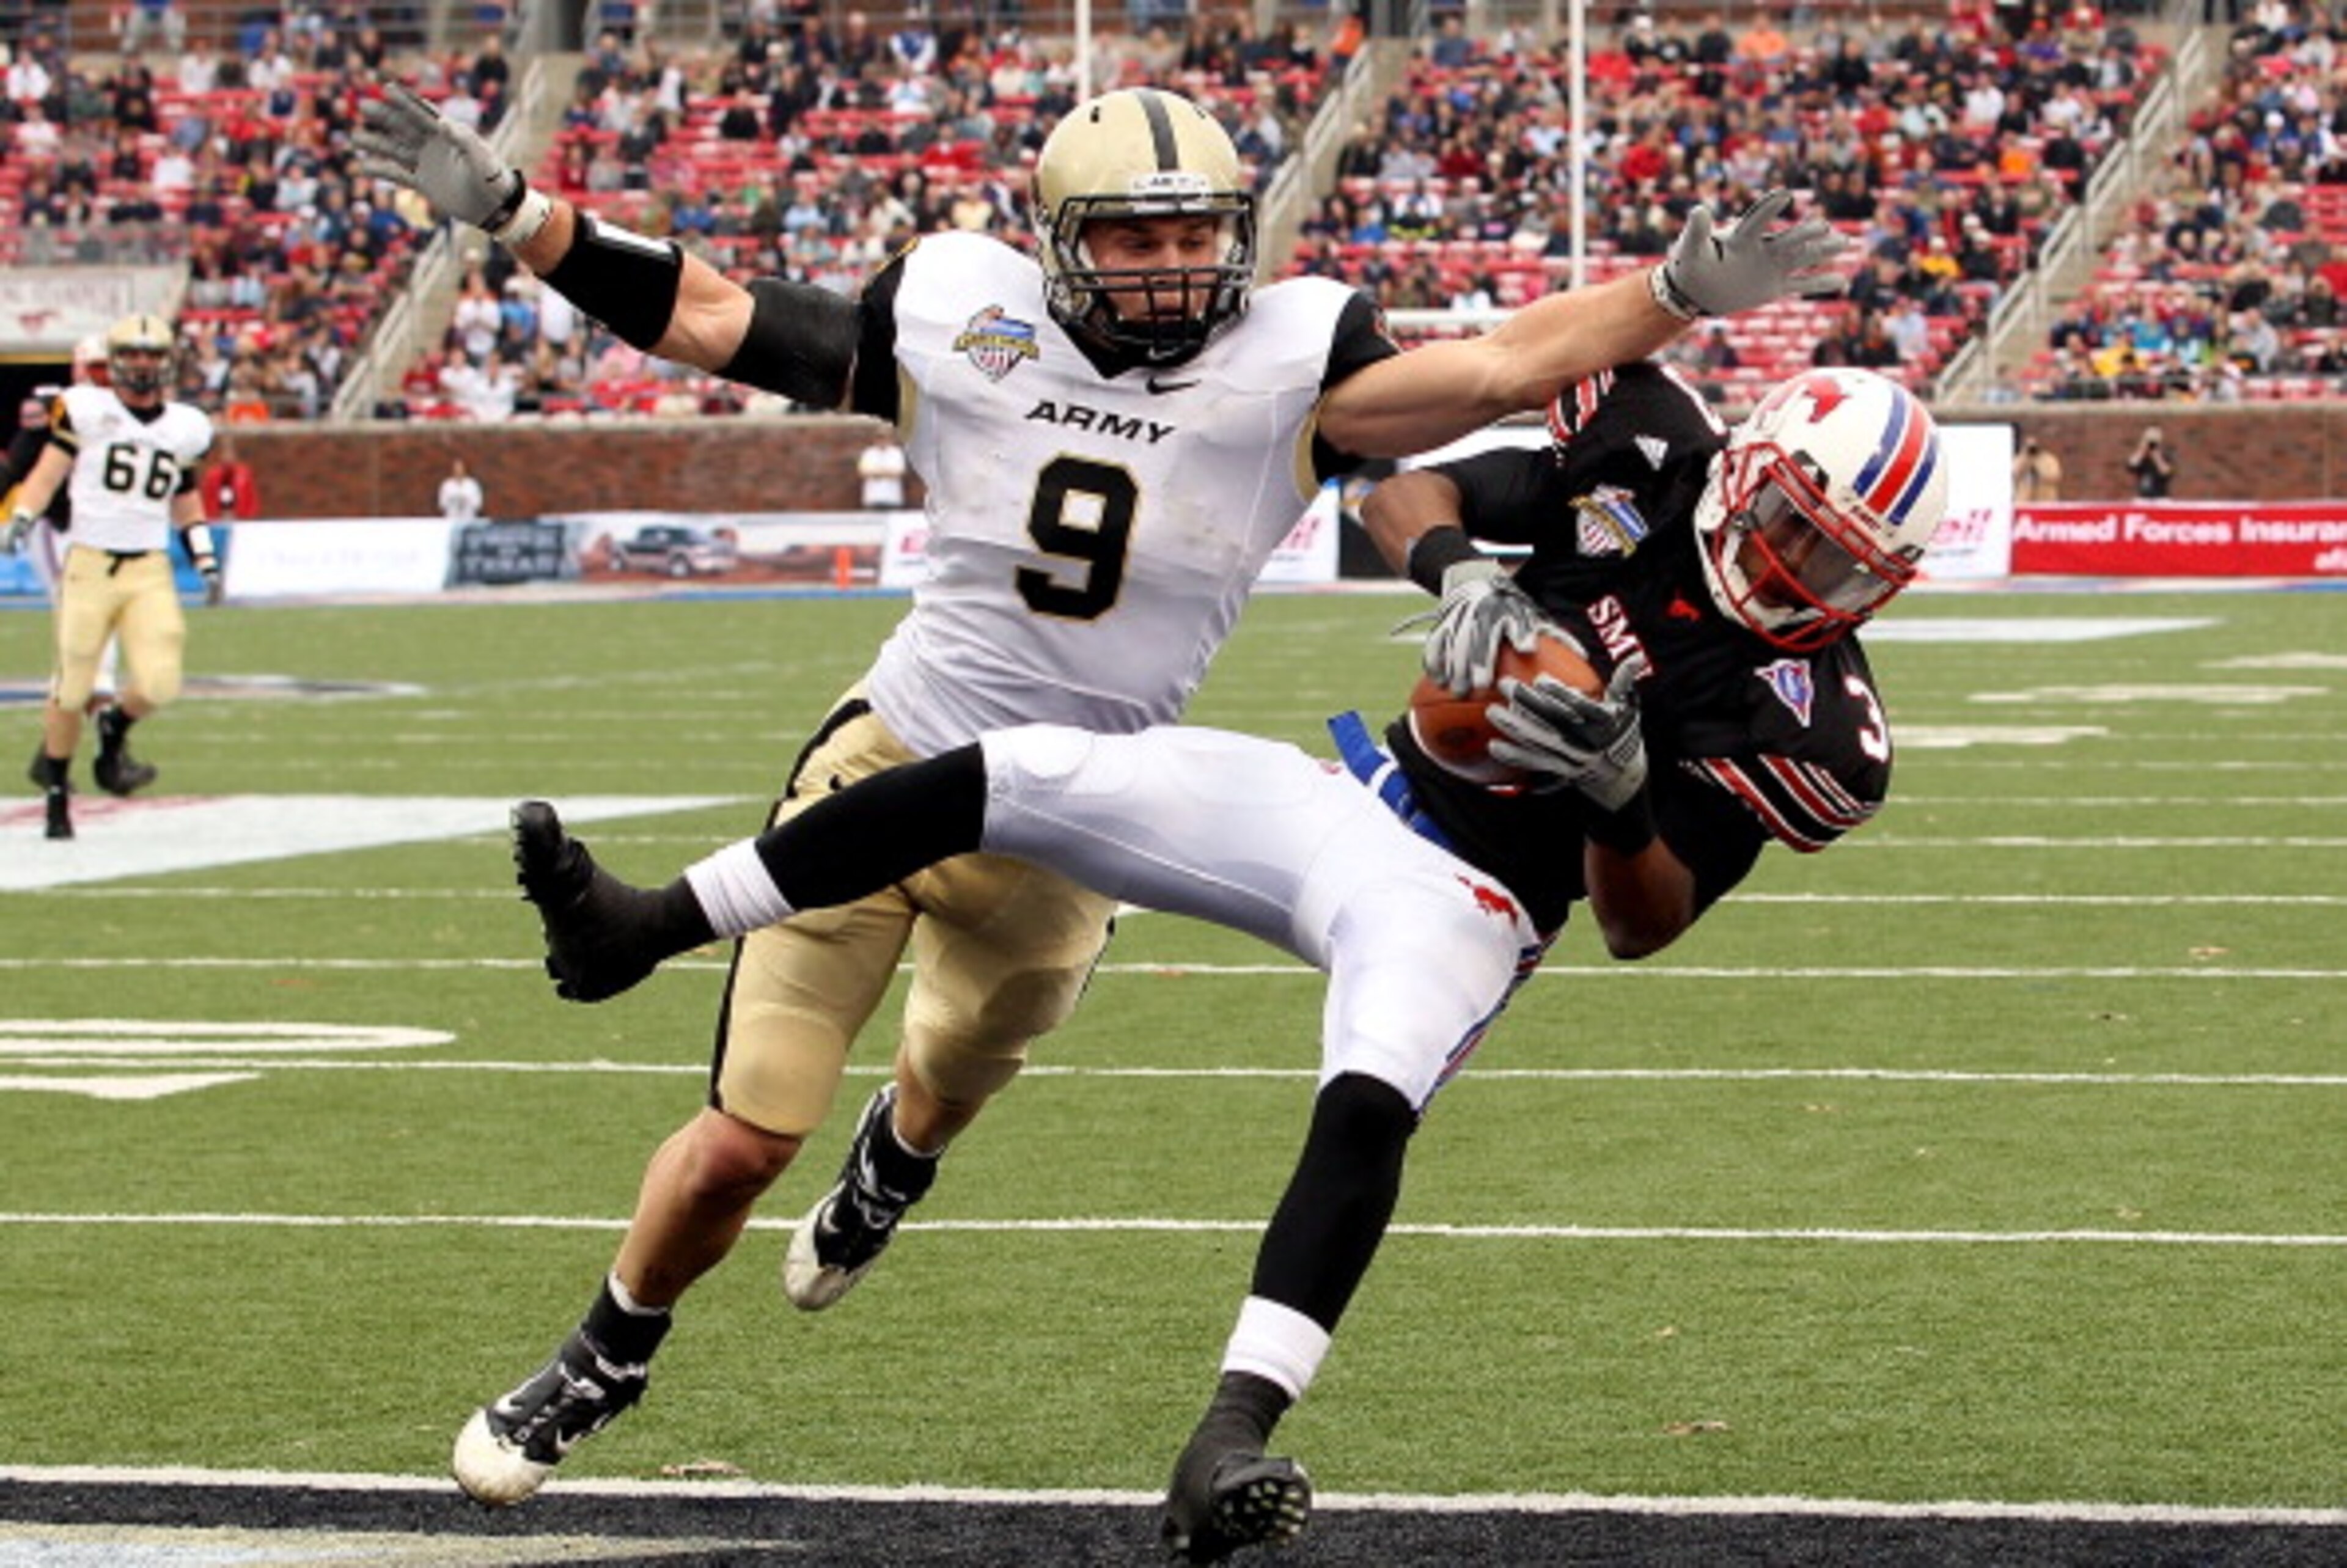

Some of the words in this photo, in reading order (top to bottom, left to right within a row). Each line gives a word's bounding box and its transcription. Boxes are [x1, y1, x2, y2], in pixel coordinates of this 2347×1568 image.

[1025, 399, 1175, 444] ARMY
[103, 442, 174, 502] 66
[1015, 452, 1140, 623] 9
[2013, 513, 2117, 543] Armed
[2124, 513, 2233, 545] Forces
[1842, 673, 1890, 764] 3
